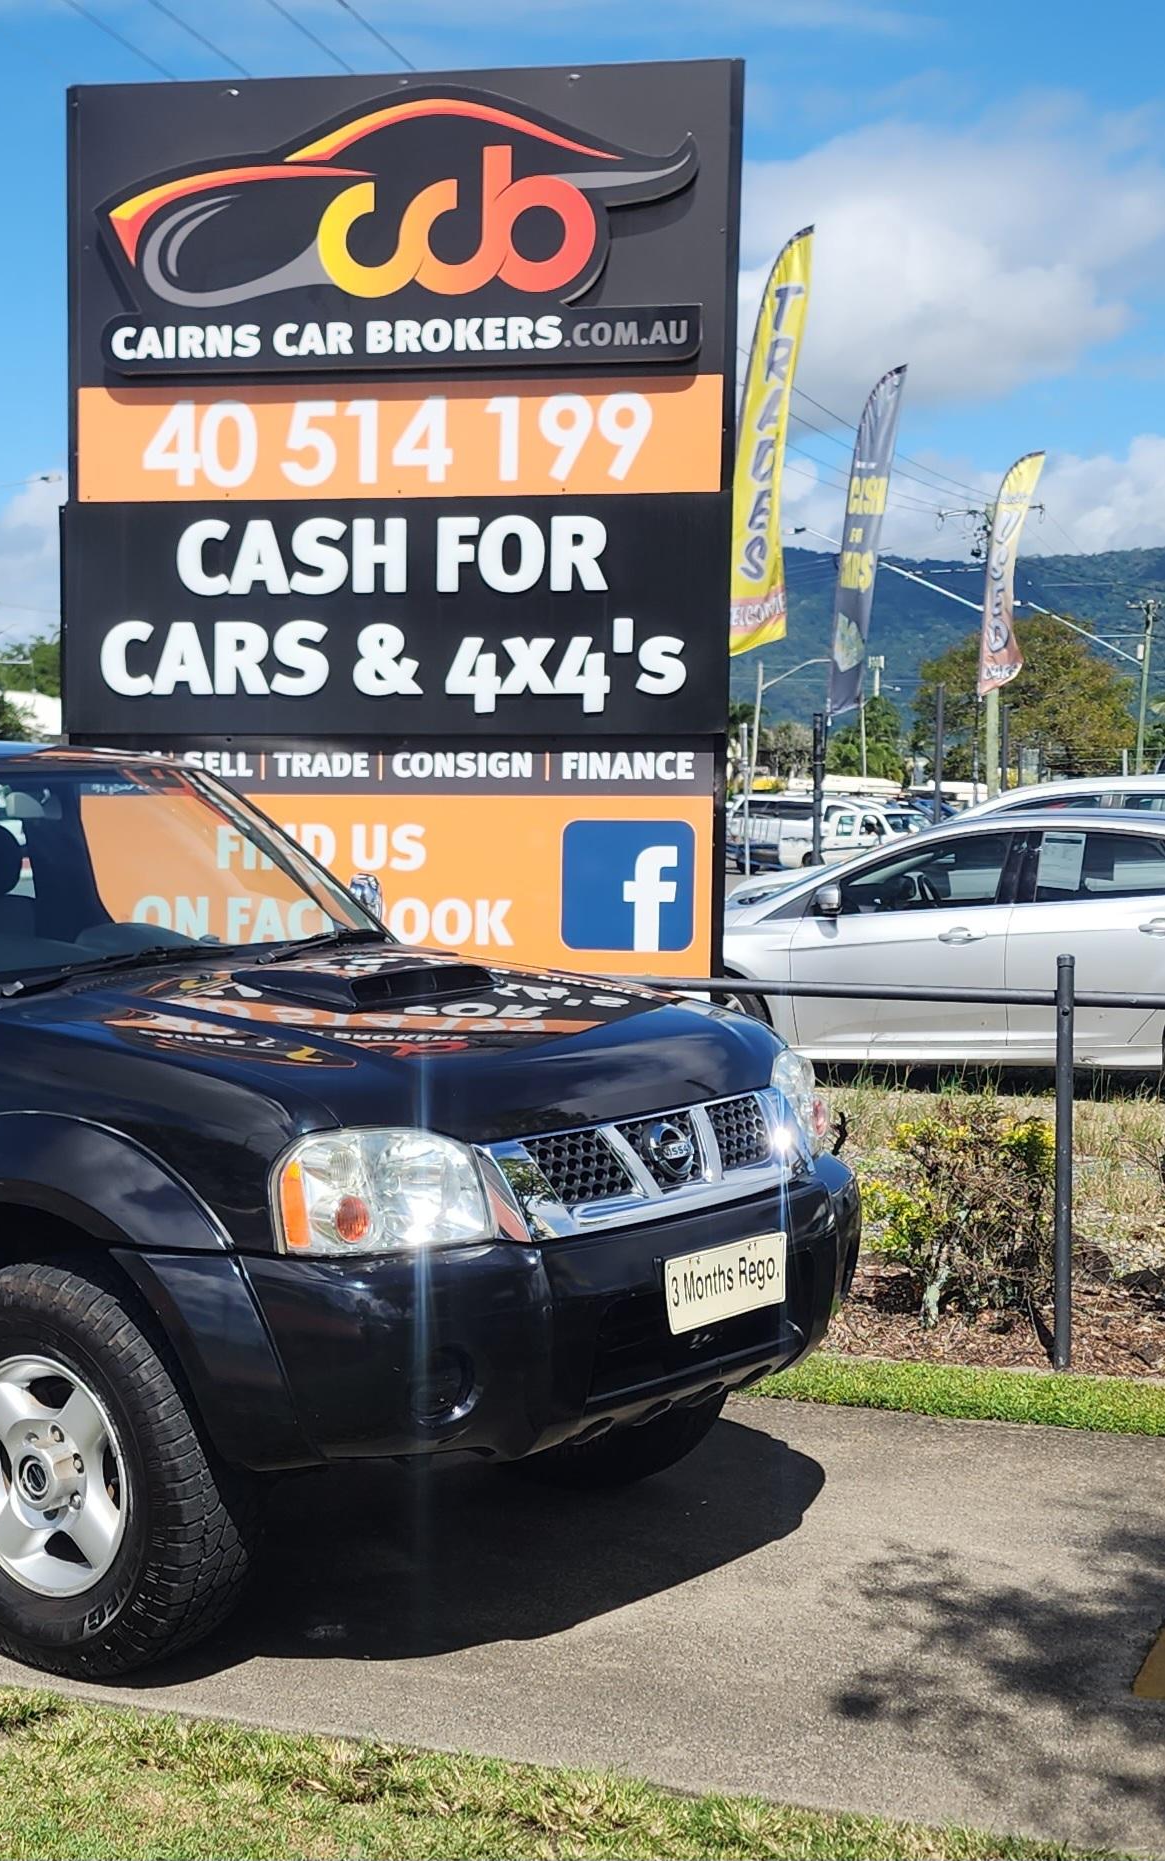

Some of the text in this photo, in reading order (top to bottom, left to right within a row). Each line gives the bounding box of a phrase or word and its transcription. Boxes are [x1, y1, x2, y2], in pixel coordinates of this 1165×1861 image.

[111, 325, 262, 361] CAIRNS
[272, 322, 354, 358] CAR
[141, 392, 654, 488] 40 514 199
[176, 514, 609, 597] CASH FOR
[100, 619, 330, 698] CARS
[352, 622, 424, 697] &
[183, 750, 695, 781] SELL TRADE CONSIGN FINANCE
[350, 823, 427, 872] US
[133, 895, 514, 946] ON FACOOK
[671, 1256, 780, 1308] 3 Months Rego.
